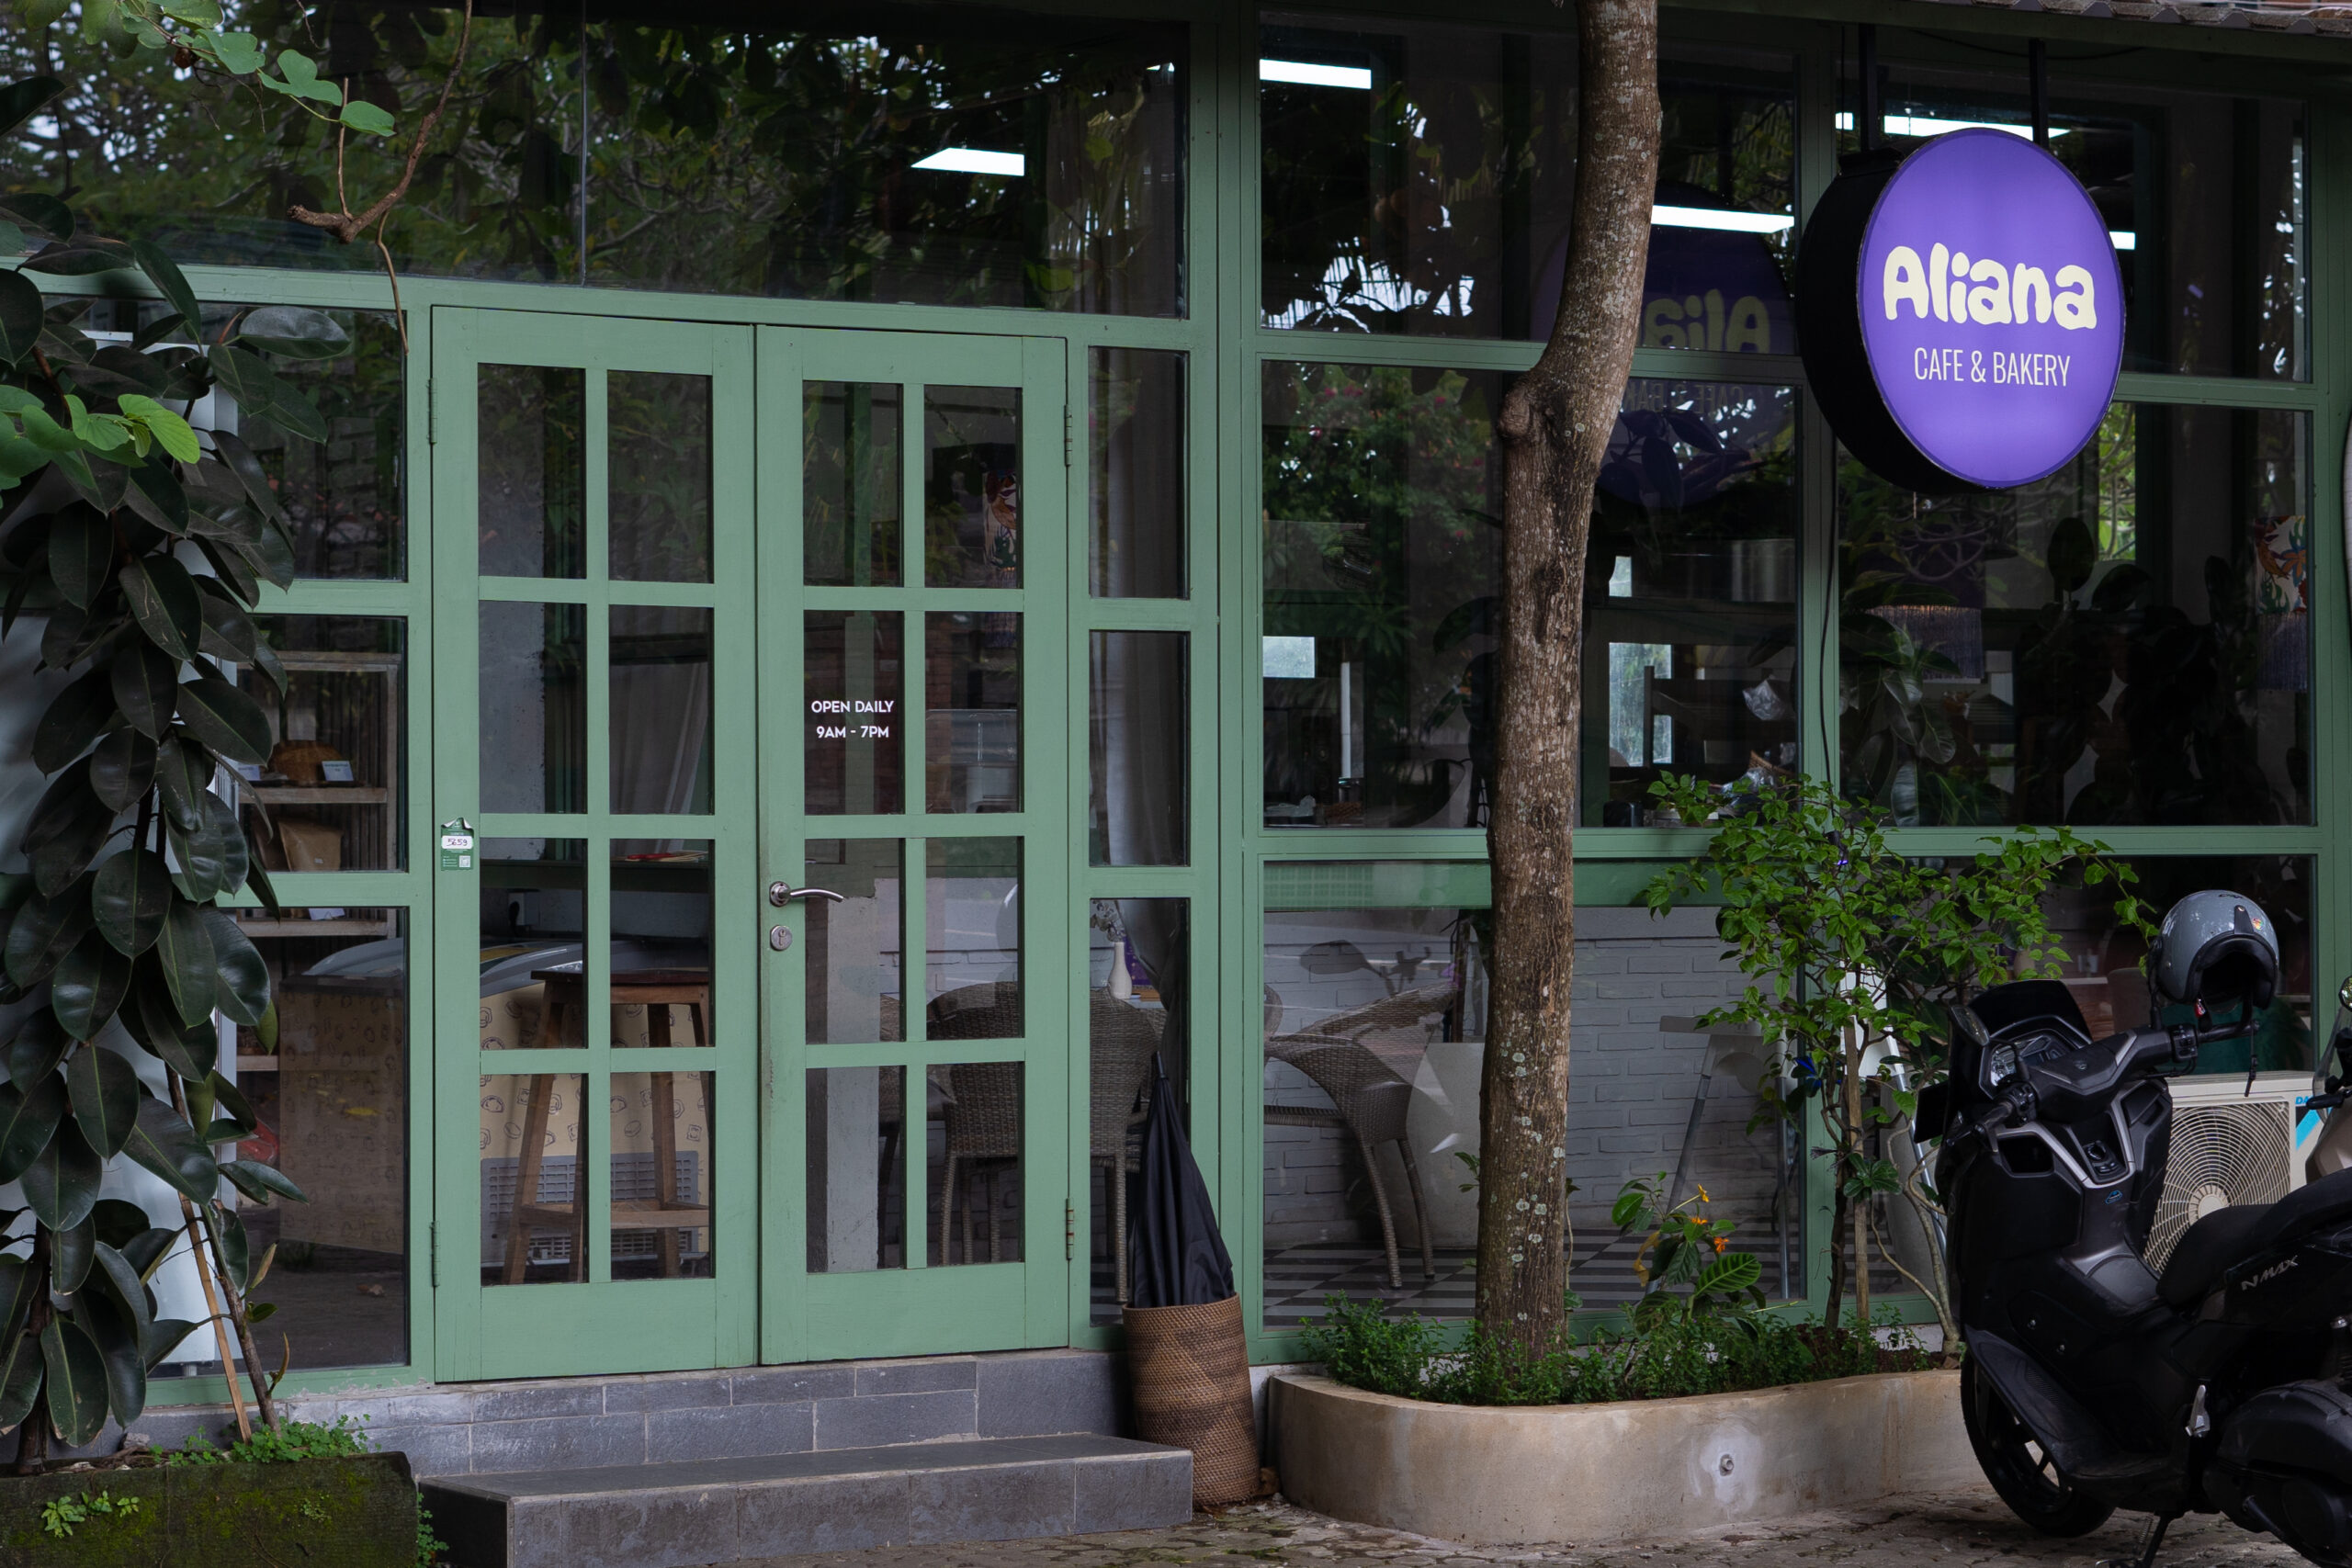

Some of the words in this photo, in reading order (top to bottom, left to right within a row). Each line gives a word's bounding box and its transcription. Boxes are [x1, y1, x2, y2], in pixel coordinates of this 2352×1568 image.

[1883, 242, 2098, 330] Aliana
[1914, 346, 1964, 382] CAFE
[1970, 349, 1986, 383] &
[1993, 351, 2071, 387] BAKERY
[810, 700, 851, 714] OPEN
[854, 700, 895, 714] DAILY
[816, 726, 846, 739] 9AM
[860, 725, 889, 739] 7PM
[2241, 1255, 2299, 1291] NMAX
